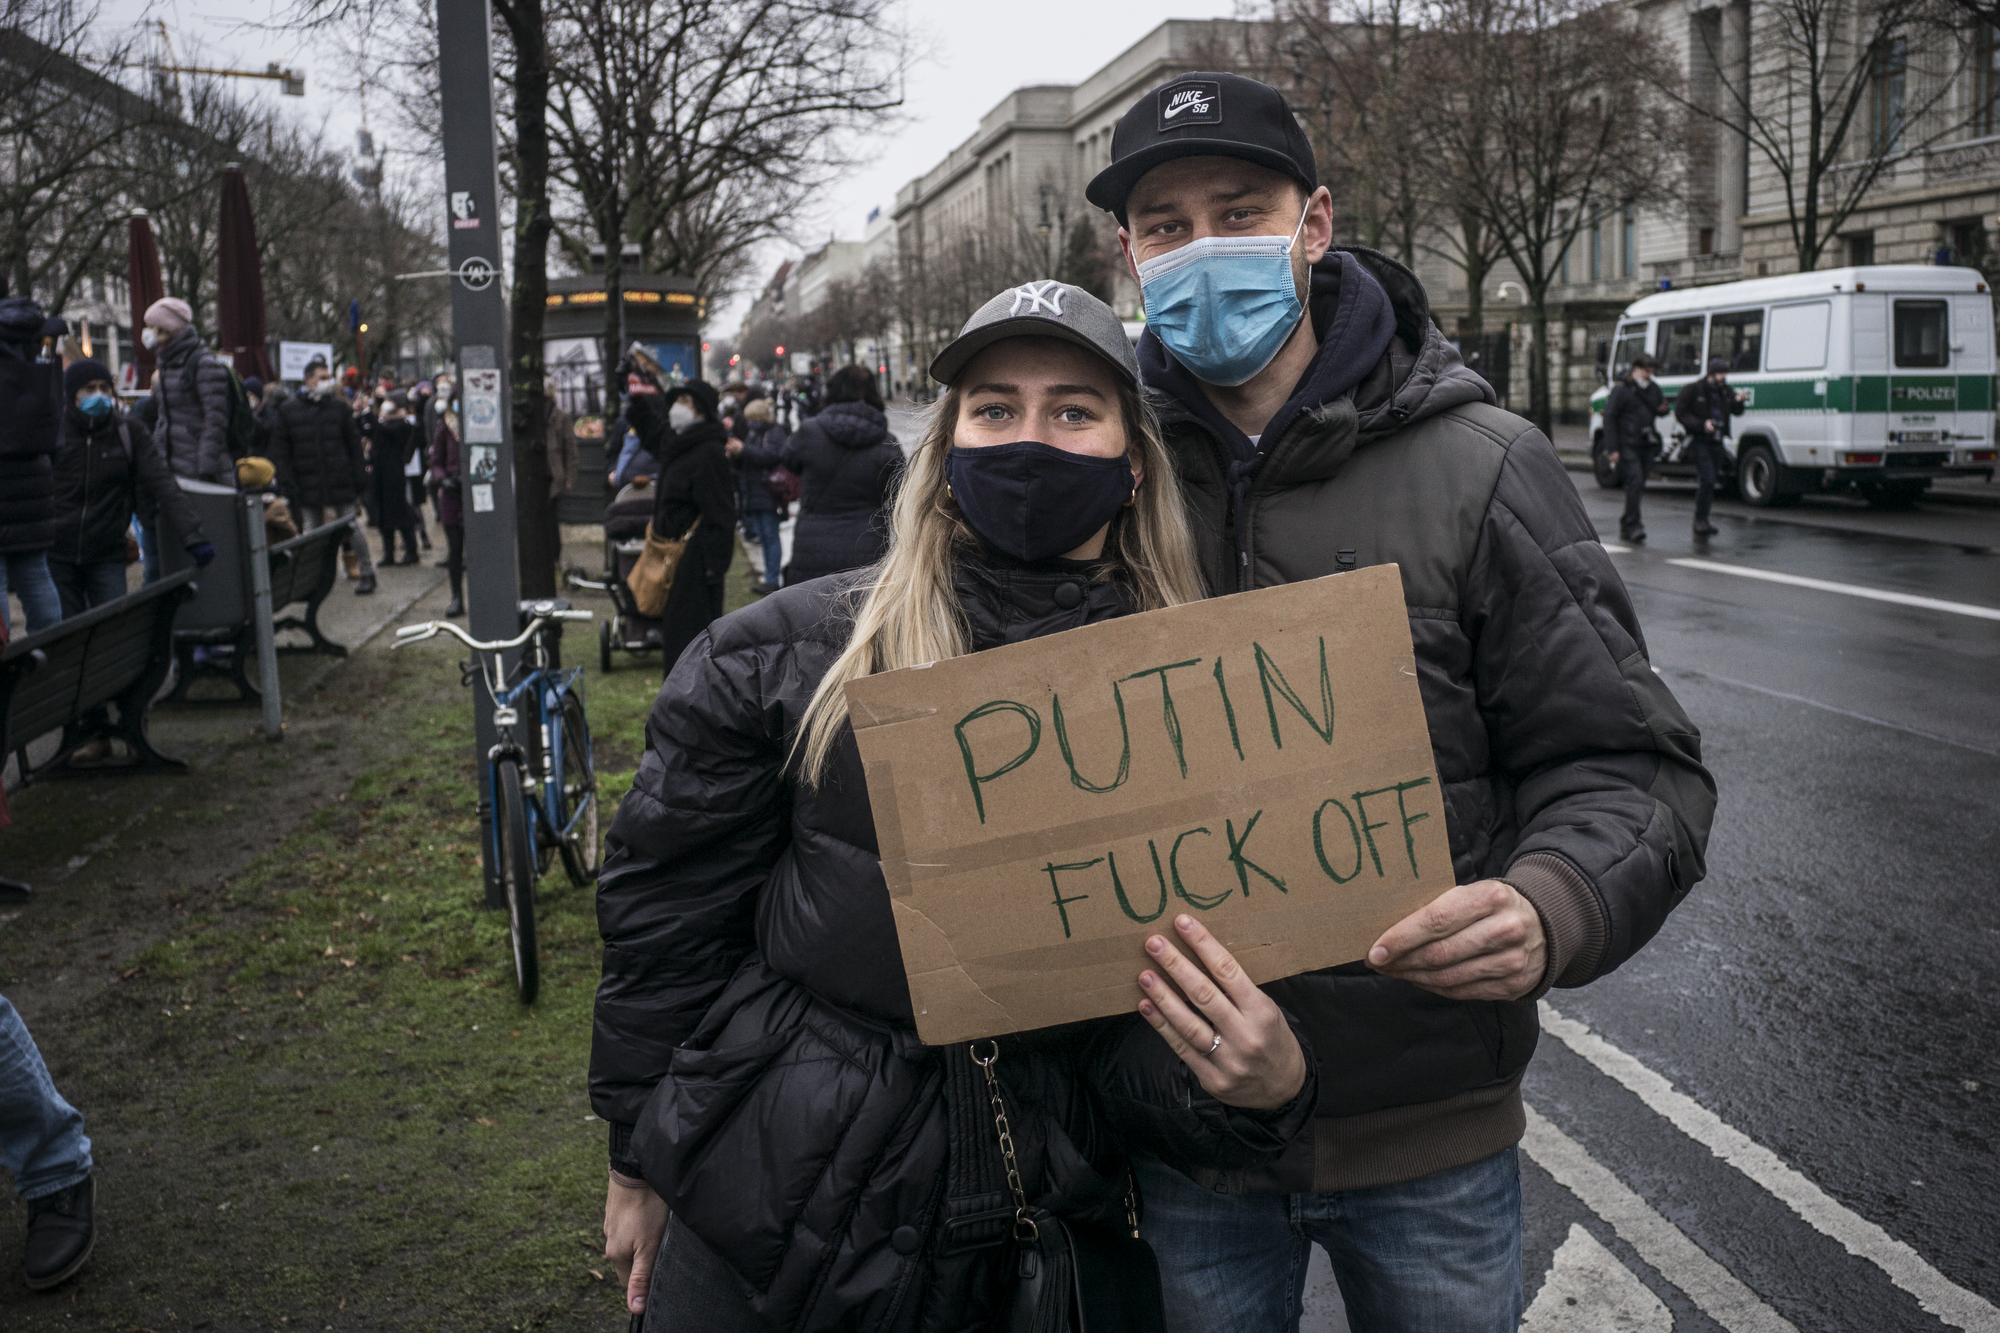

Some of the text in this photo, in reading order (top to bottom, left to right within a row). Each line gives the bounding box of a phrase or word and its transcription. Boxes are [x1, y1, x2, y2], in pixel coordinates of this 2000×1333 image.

[1171, 91, 1203, 107] NIKE
[1192, 103, 1209, 113] SB
[1009, 280, 1067, 317] NY
[1907, 386, 1957, 400] POLIZEI
[954, 636, 1335, 825] PUTIN
[1041, 776, 1433, 939] FUCK OFF
